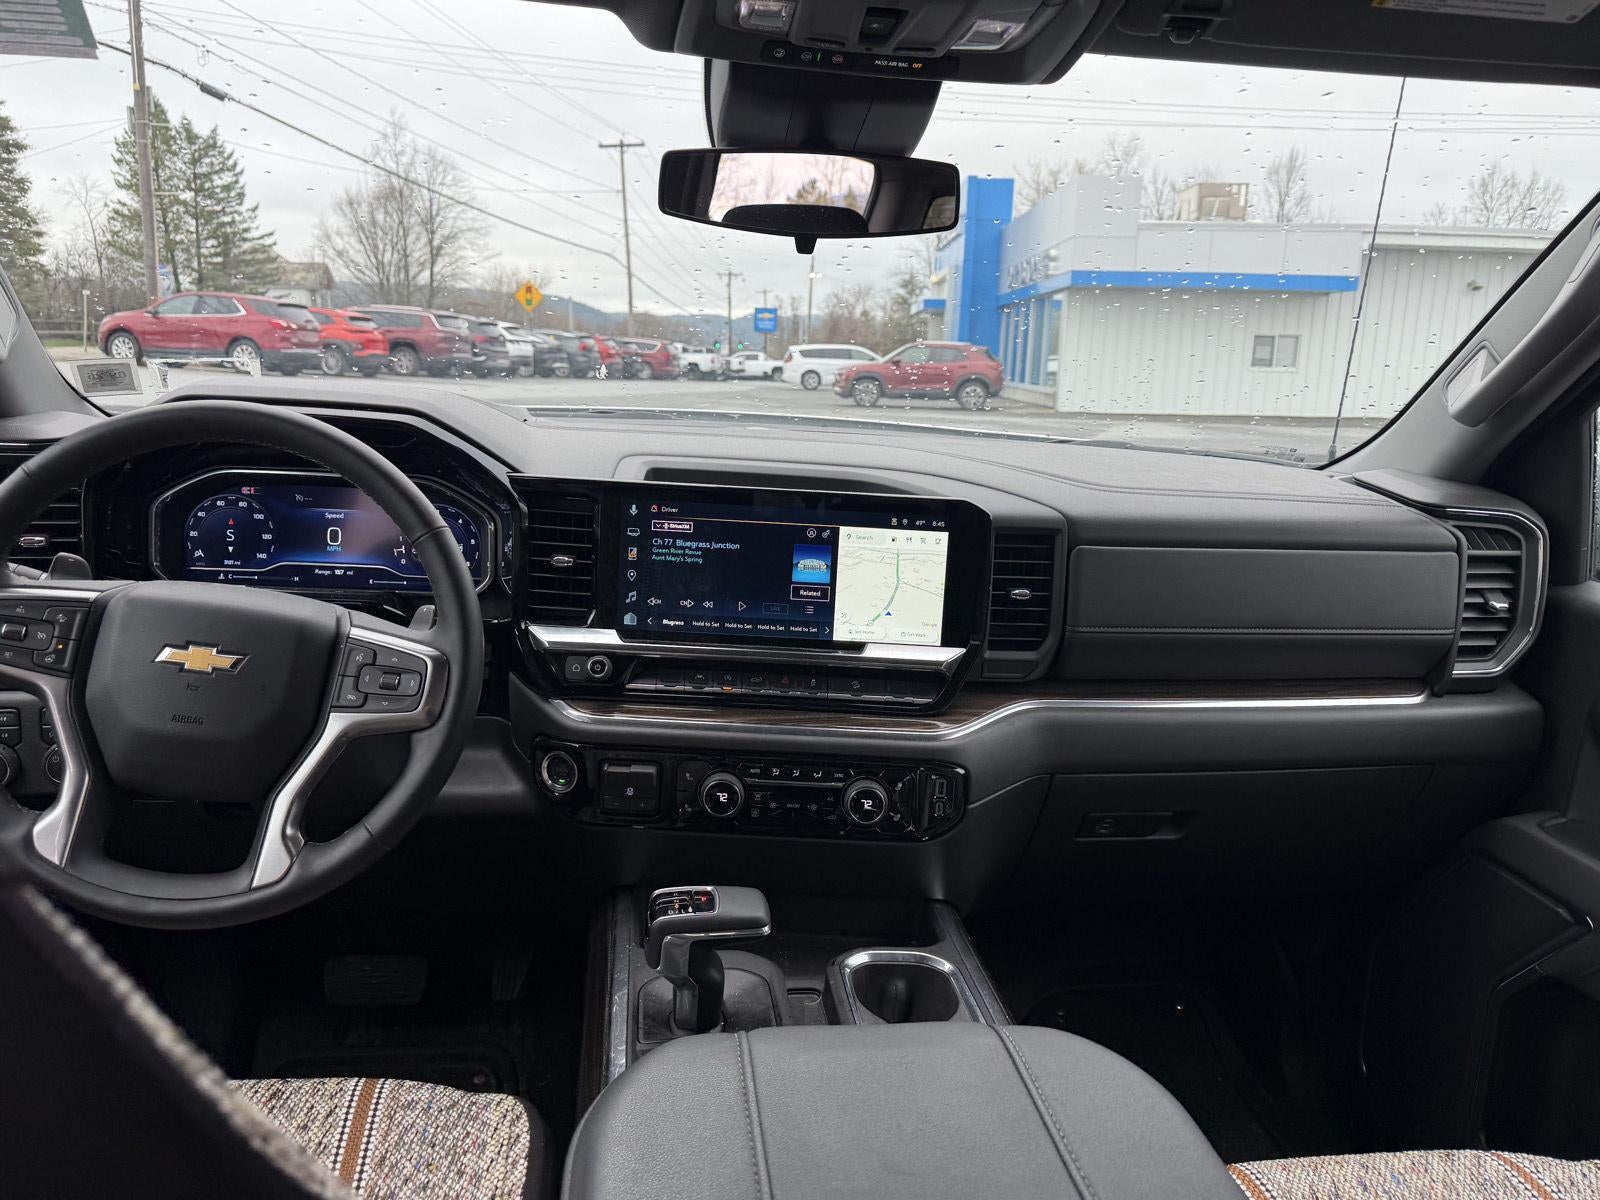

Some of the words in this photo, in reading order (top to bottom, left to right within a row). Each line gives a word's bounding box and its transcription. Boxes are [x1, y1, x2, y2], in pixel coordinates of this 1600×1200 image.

[226, 529, 235, 541] S
[327, 527, 341, 545] 0
[652, 538, 662, 546] Ch
[676, 539, 710, 548] Bluegrass
[711, 542, 740, 550] Junction
[684, 556, 703, 564] Spring
[800, 589, 820, 597] Related
[171, 714, 204, 726] AIRBAG
[716, 792, 728, 802] 72
[861, 800, 872, 808] 72
